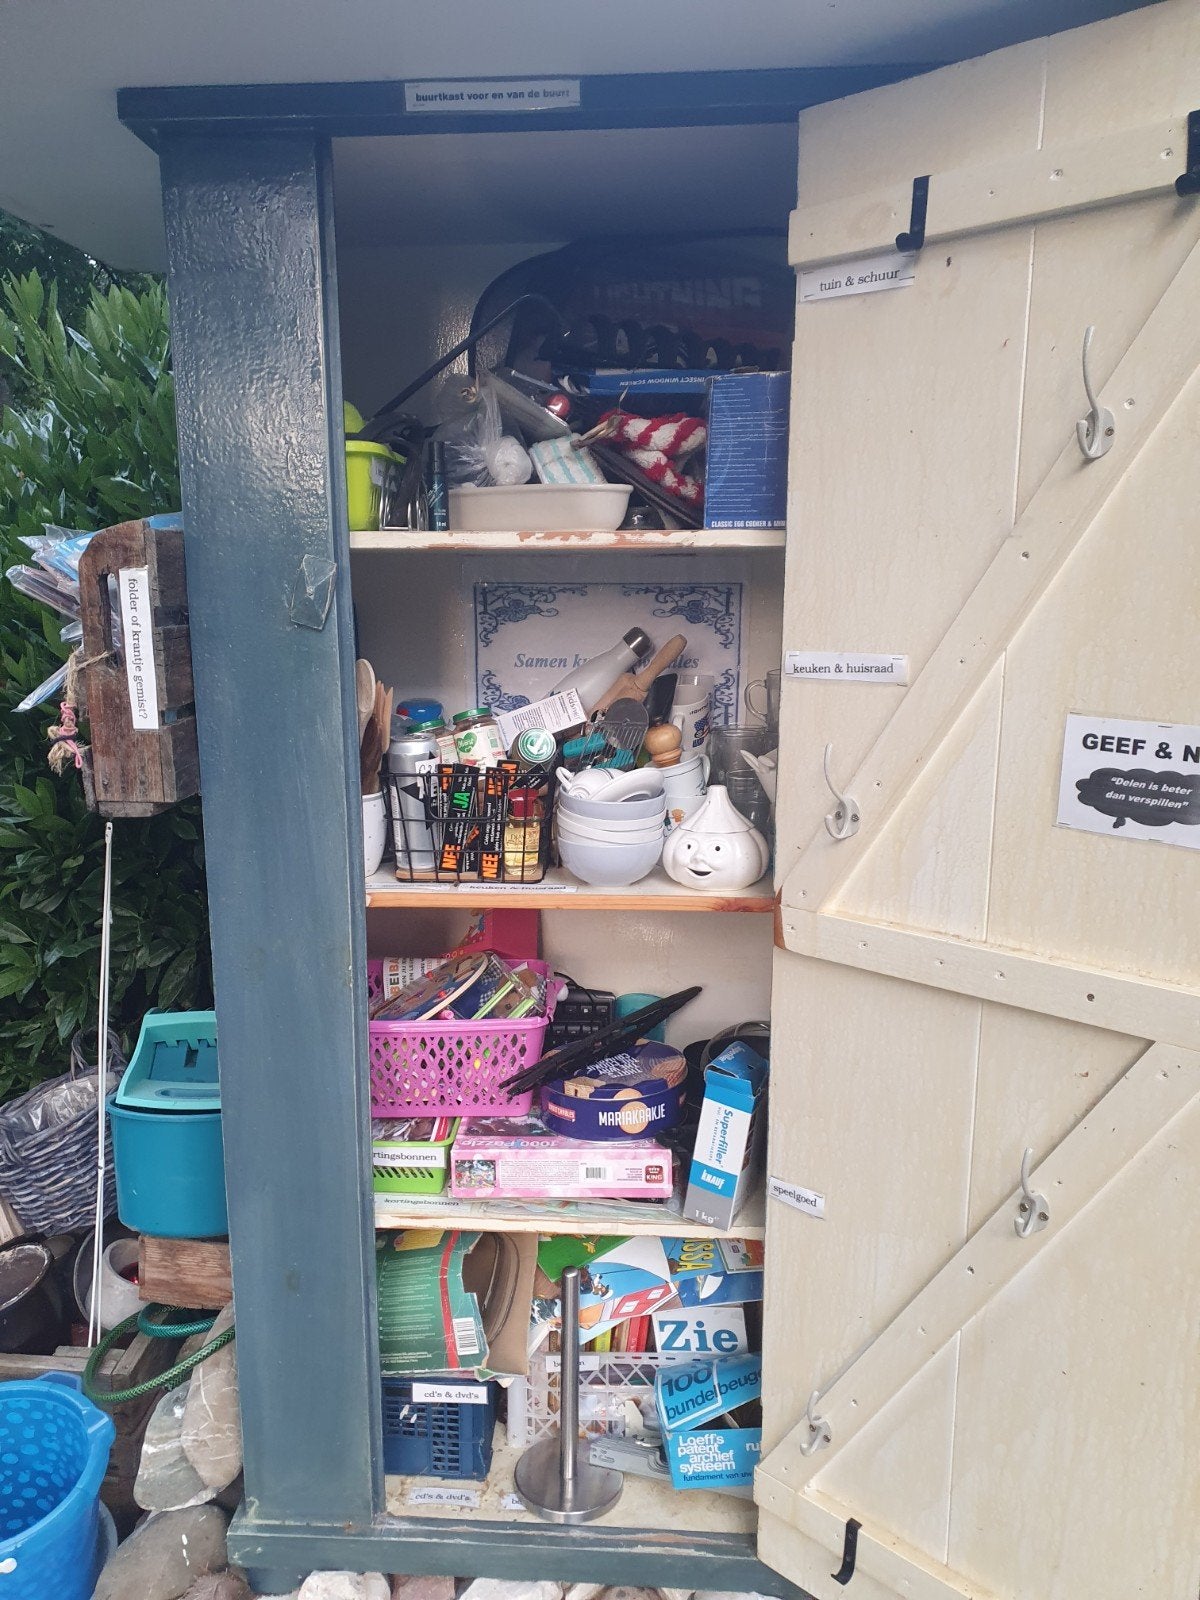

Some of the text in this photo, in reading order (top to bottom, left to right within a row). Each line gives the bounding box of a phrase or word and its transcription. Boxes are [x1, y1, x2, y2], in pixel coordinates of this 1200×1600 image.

[415, 92, 464, 102] buurtkast
[467, 92, 489, 100] voor
[507, 91, 525, 99] van
[527, 89, 540, 98] de
[543, 88, 570, 98] buurt
[819, 269, 900, 291] tuin & schuur
[711, 520, 733, 528] CLASSIC
[734, 520, 745, 528] EGG
[745, 520, 767, 528] COOKER
[128, 577, 149, 720] folder of krantje gemist?
[514, 653, 569, 669] Samen
[793, 663, 894, 674] keuken & huisraad
[1082, 733, 1146, 756] GEEF
[1155, 742, 1173, 760] &
[1105, 790, 1126, 801] dan
[1148, 781, 1158, 791] is
[1161, 782, 1193, 795] beter
[453, 791, 470, 809] JA
[441, 844, 457, 869] NEE
[482, 853, 499, 878] NEE
[598, 1103, 666, 1127] MARIAKAAKJE
[714, 1109, 733, 1165] Superfiller
[384, 1198, 460, 1206] kortingsbonnen
[773, 1185, 817, 1207] speelgoed
[695, 1209, 714, 1224] 1 kg
[677, 1238, 714, 1271] SSA
[659, 1320, 739, 1352] Zie
[662, 1369, 713, 1397] 100
[455, 1391, 480, 1399] dvd's
[678, 1433, 725, 1446] Loeff's
[677, 1443, 719, 1457] patent
[689, 1449, 735, 1463] archief
[679, 1460, 736, 1475] systeem
[414, 1492, 433, 1500] cd's
[446, 1493, 471, 1501] dvd's
